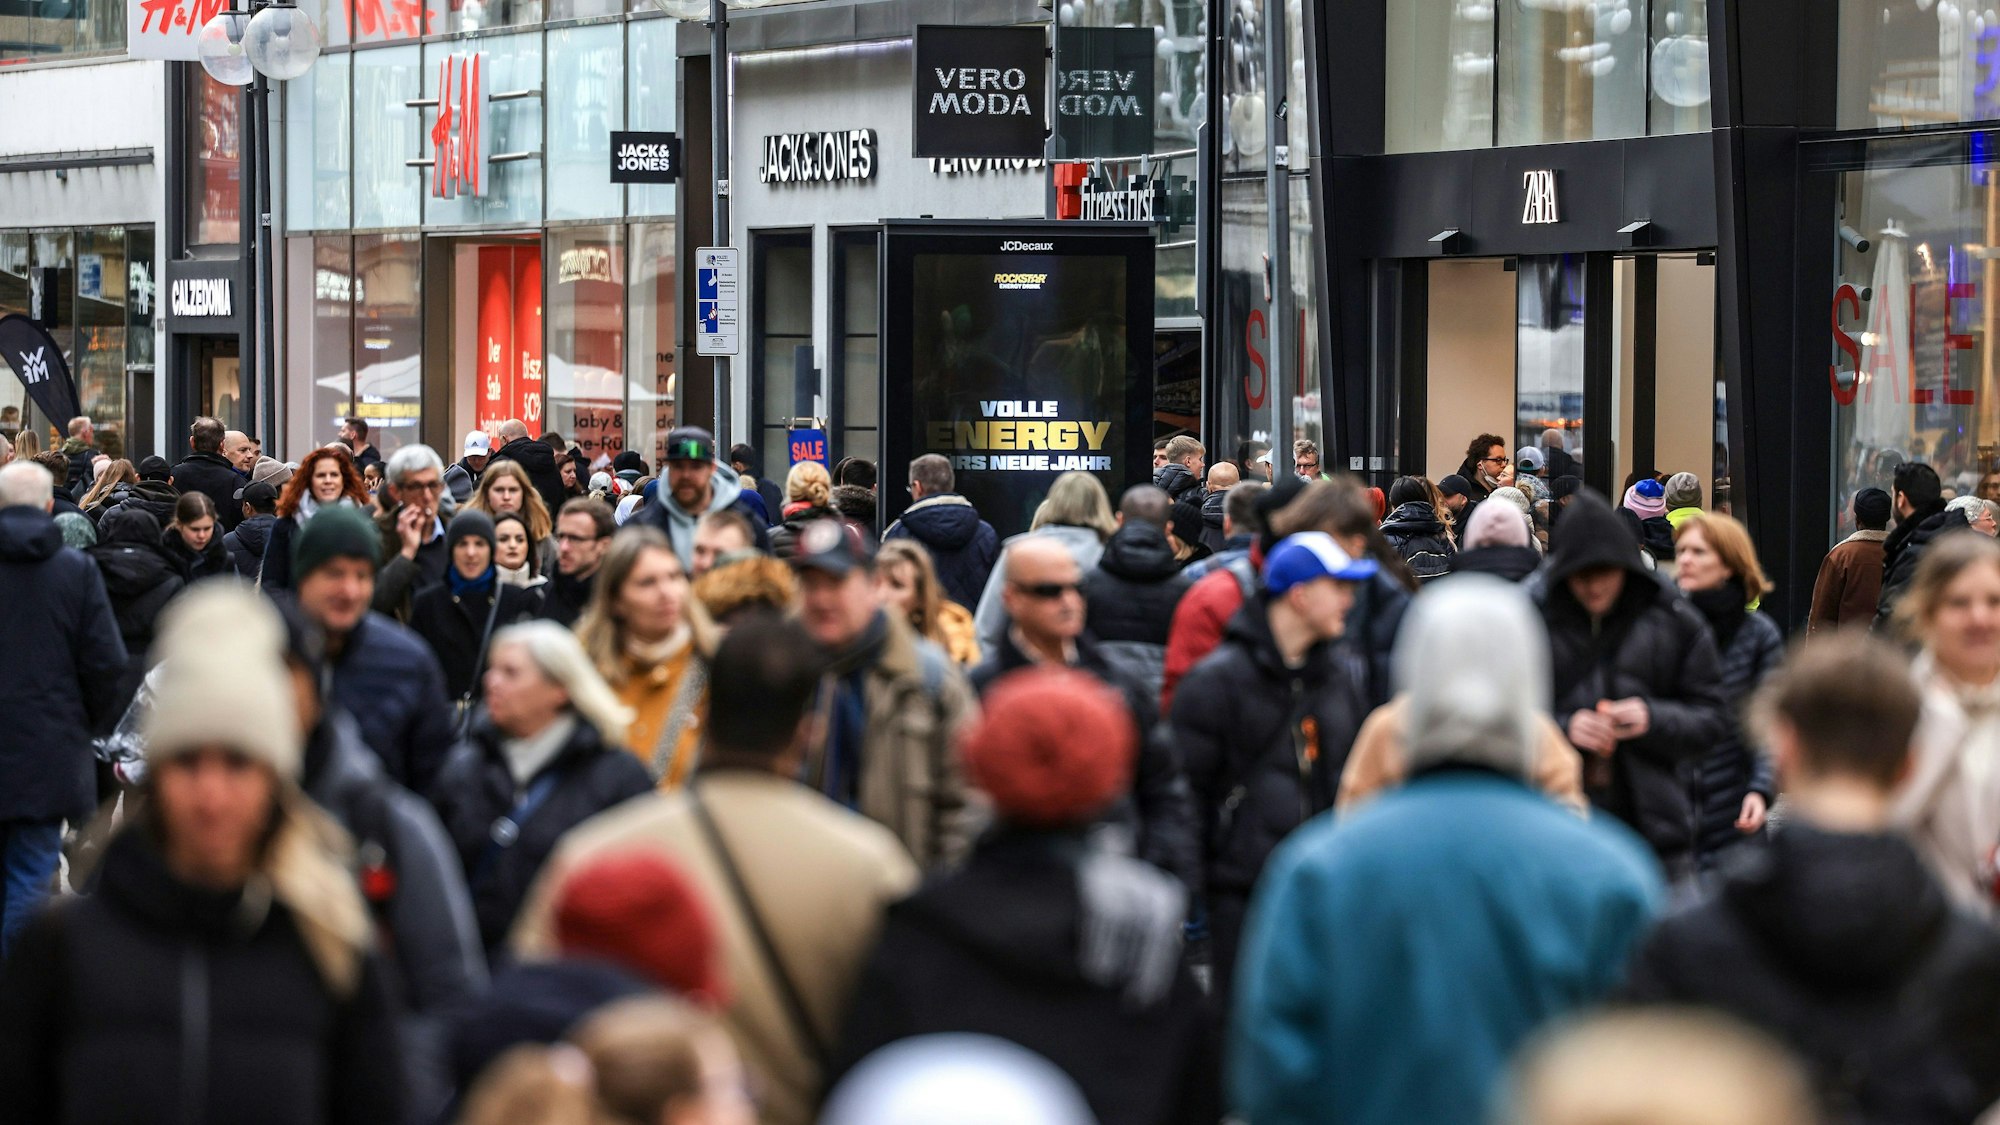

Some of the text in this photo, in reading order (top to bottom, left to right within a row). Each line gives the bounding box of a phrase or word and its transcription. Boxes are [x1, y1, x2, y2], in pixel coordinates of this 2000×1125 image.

[935, 68, 1026, 90] VERO
[929, 93, 1032, 115] MODA
[431, 52, 481, 199] H&M
[617, 143, 670, 158] JACK&
[617, 158, 670, 172] JONES
[1522, 169, 1558, 224] ZARA
[1000, 241, 1053, 251] JCDecaux
[993, 273, 1047, 284] ROCKSTAR
[171, 278, 232, 316] CALZEDONIA
[1829, 283, 1976, 406] SALE
[980, 400, 1059, 418] VOLLE
[926, 421, 1112, 451] ENERGY
[791, 440, 825, 462] SALE
[946, 453, 1112, 471] RS NEUE JAHR
